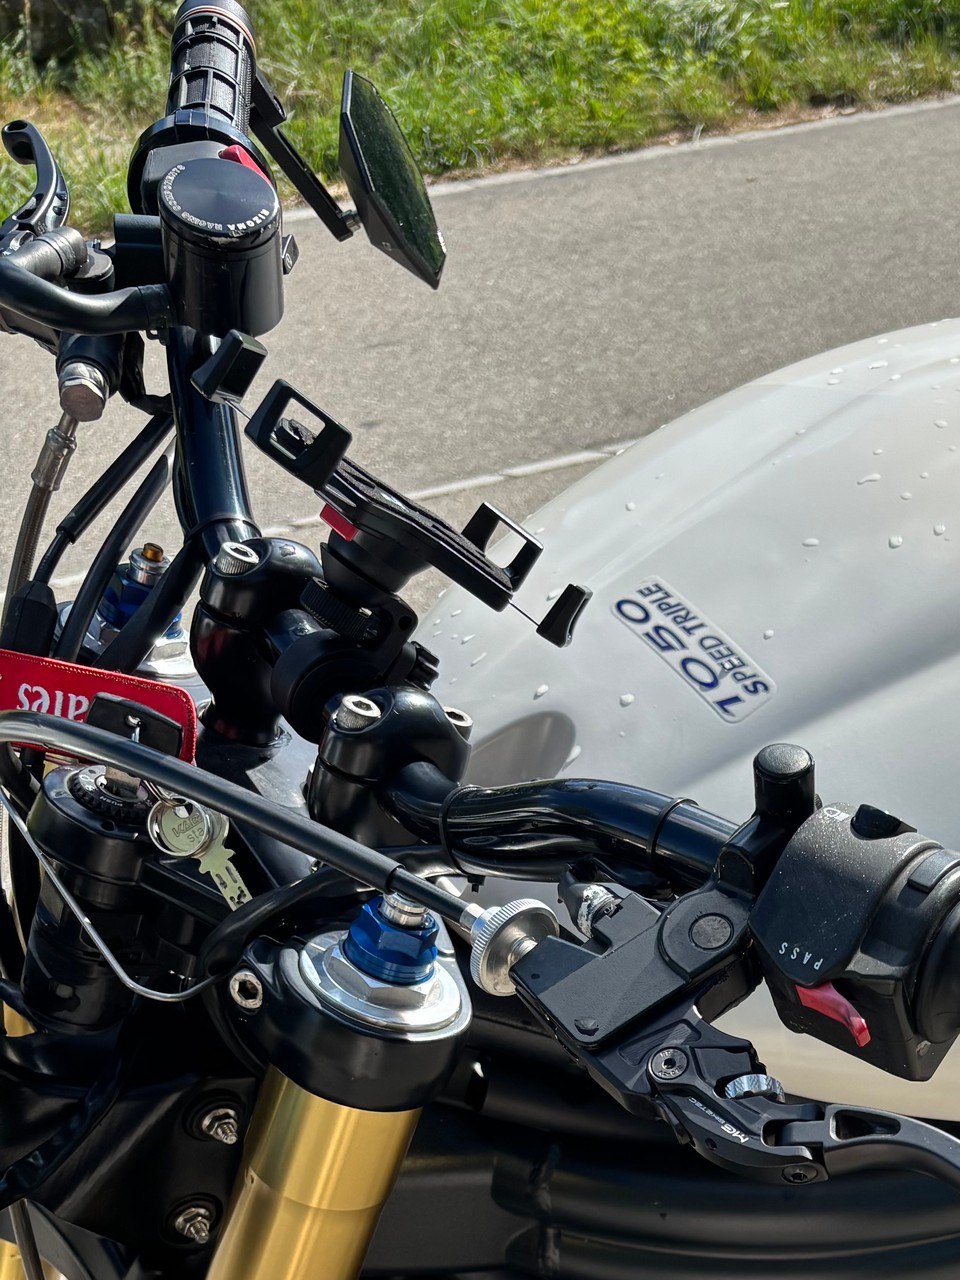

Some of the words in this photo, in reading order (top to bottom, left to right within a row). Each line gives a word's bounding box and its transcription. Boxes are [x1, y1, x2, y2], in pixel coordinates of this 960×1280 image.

[181, 211, 222, 231] RACING
[227, 208, 270, 231] RIZOMA
[637, 583, 708, 637] TRIPLE
[615, 599, 746, 717] 1050
[699, 635, 770, 696] SPEED
[779, 942, 823, 970] PASS
[721, 1123, 749, 1143] MG
